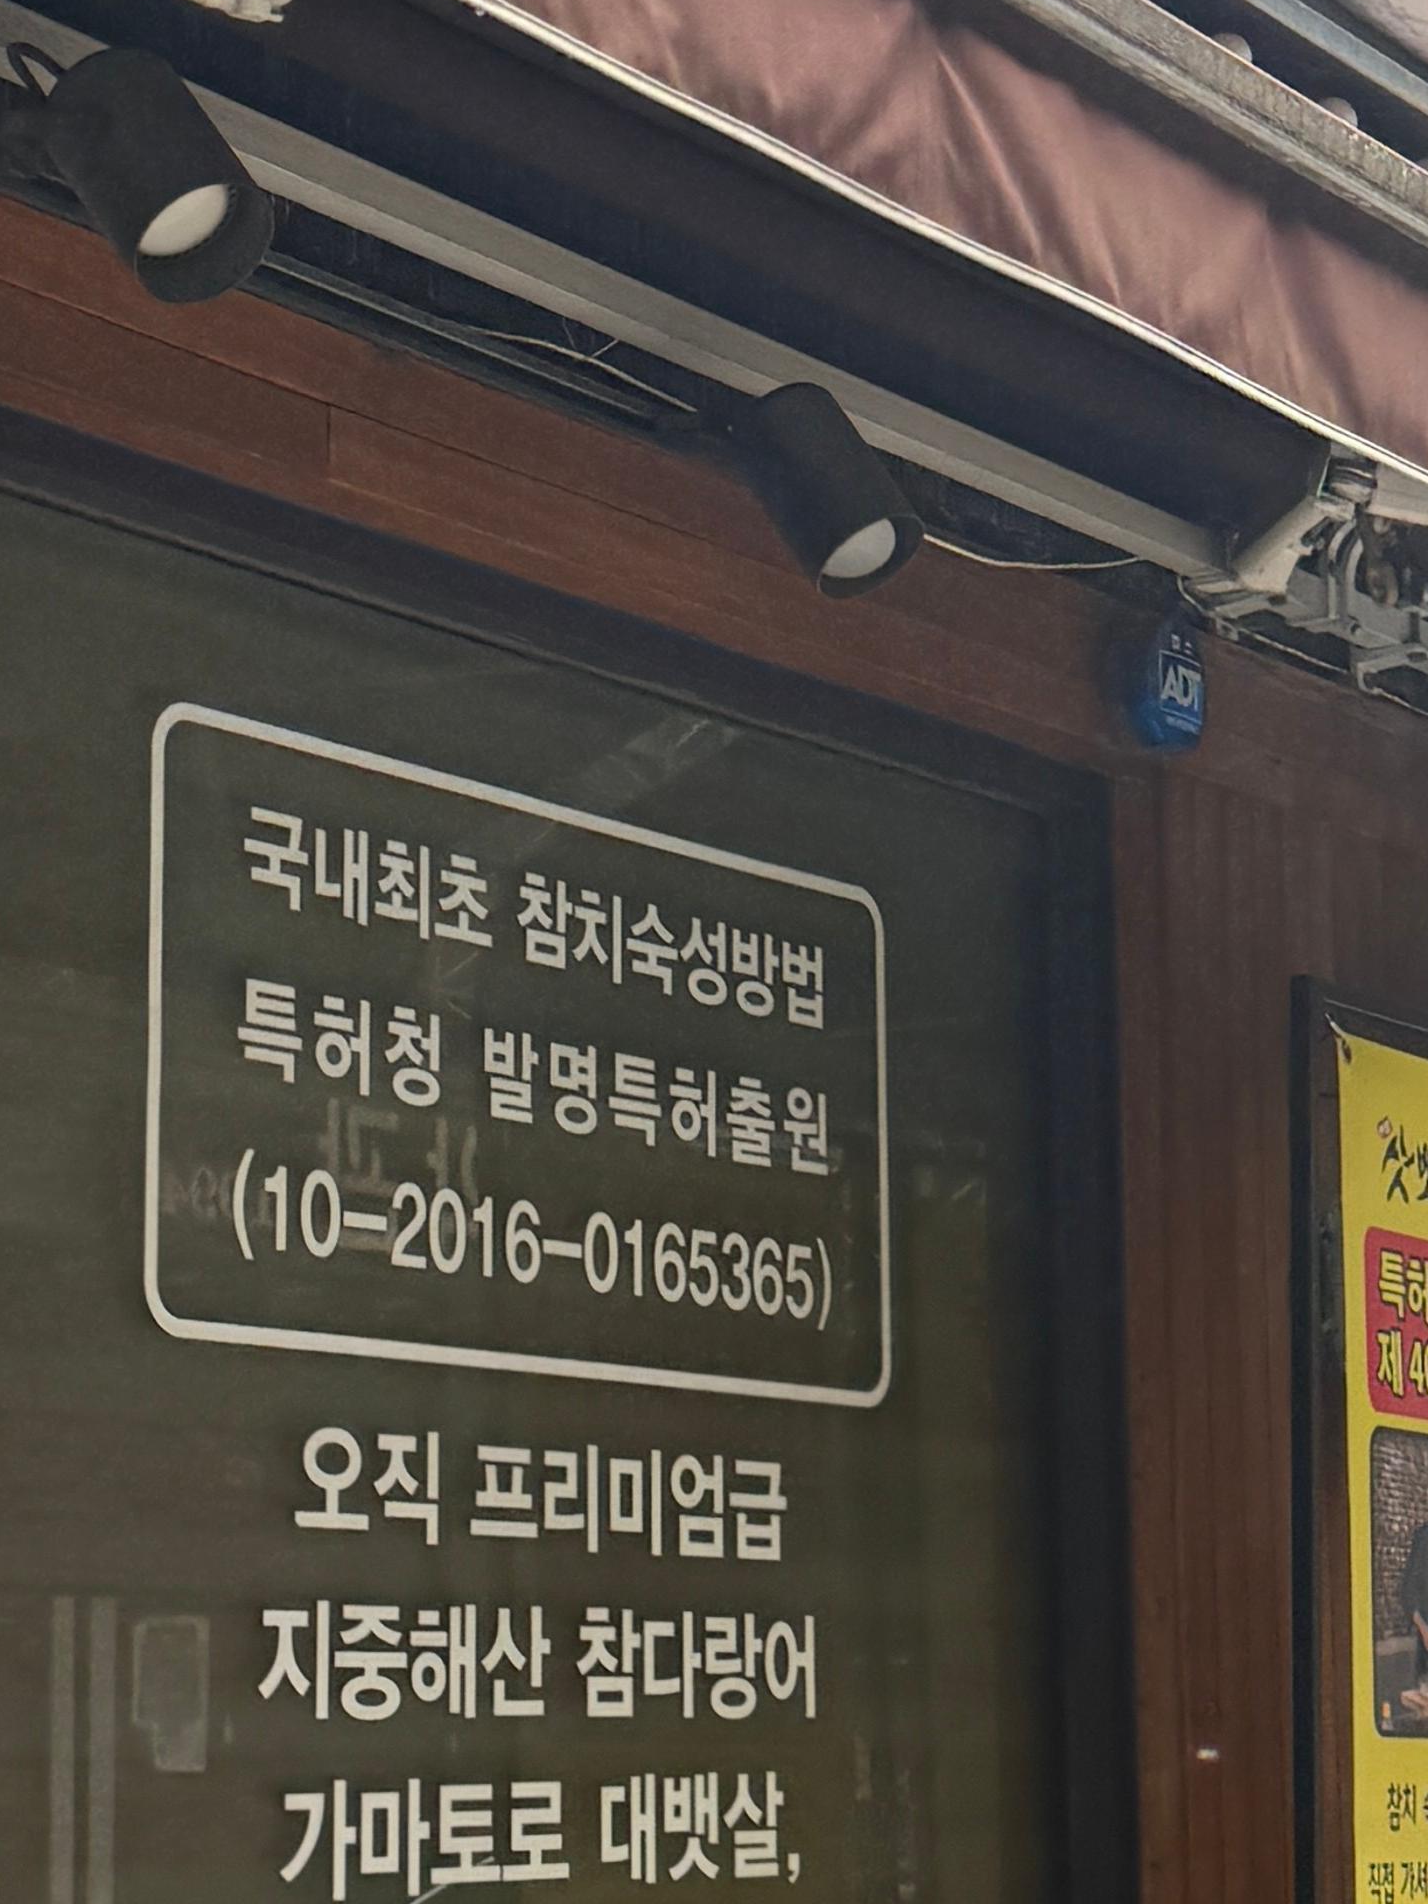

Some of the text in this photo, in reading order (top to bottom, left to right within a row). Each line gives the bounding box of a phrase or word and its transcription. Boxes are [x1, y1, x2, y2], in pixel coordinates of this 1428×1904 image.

[1160, 664, 1202, 712] ADT
[243, 805, 825, 1030] 국내최초 참치숙성방법
[237, 978, 829, 1177] 특허청 발명특허출원
[231, 1147, 834, 1331] (10-2016-0165365)
[1376, 1327, 1405, 1399] 제
[294, 1426, 788, 1562] 오직 프리미엄급
[258, 1599, 817, 1720] 지중해산 참다랑어
[280, 1771, 801, 1901] 가마토로 대뱃살,
[1386, 1783, 1417, 1832] 참치
